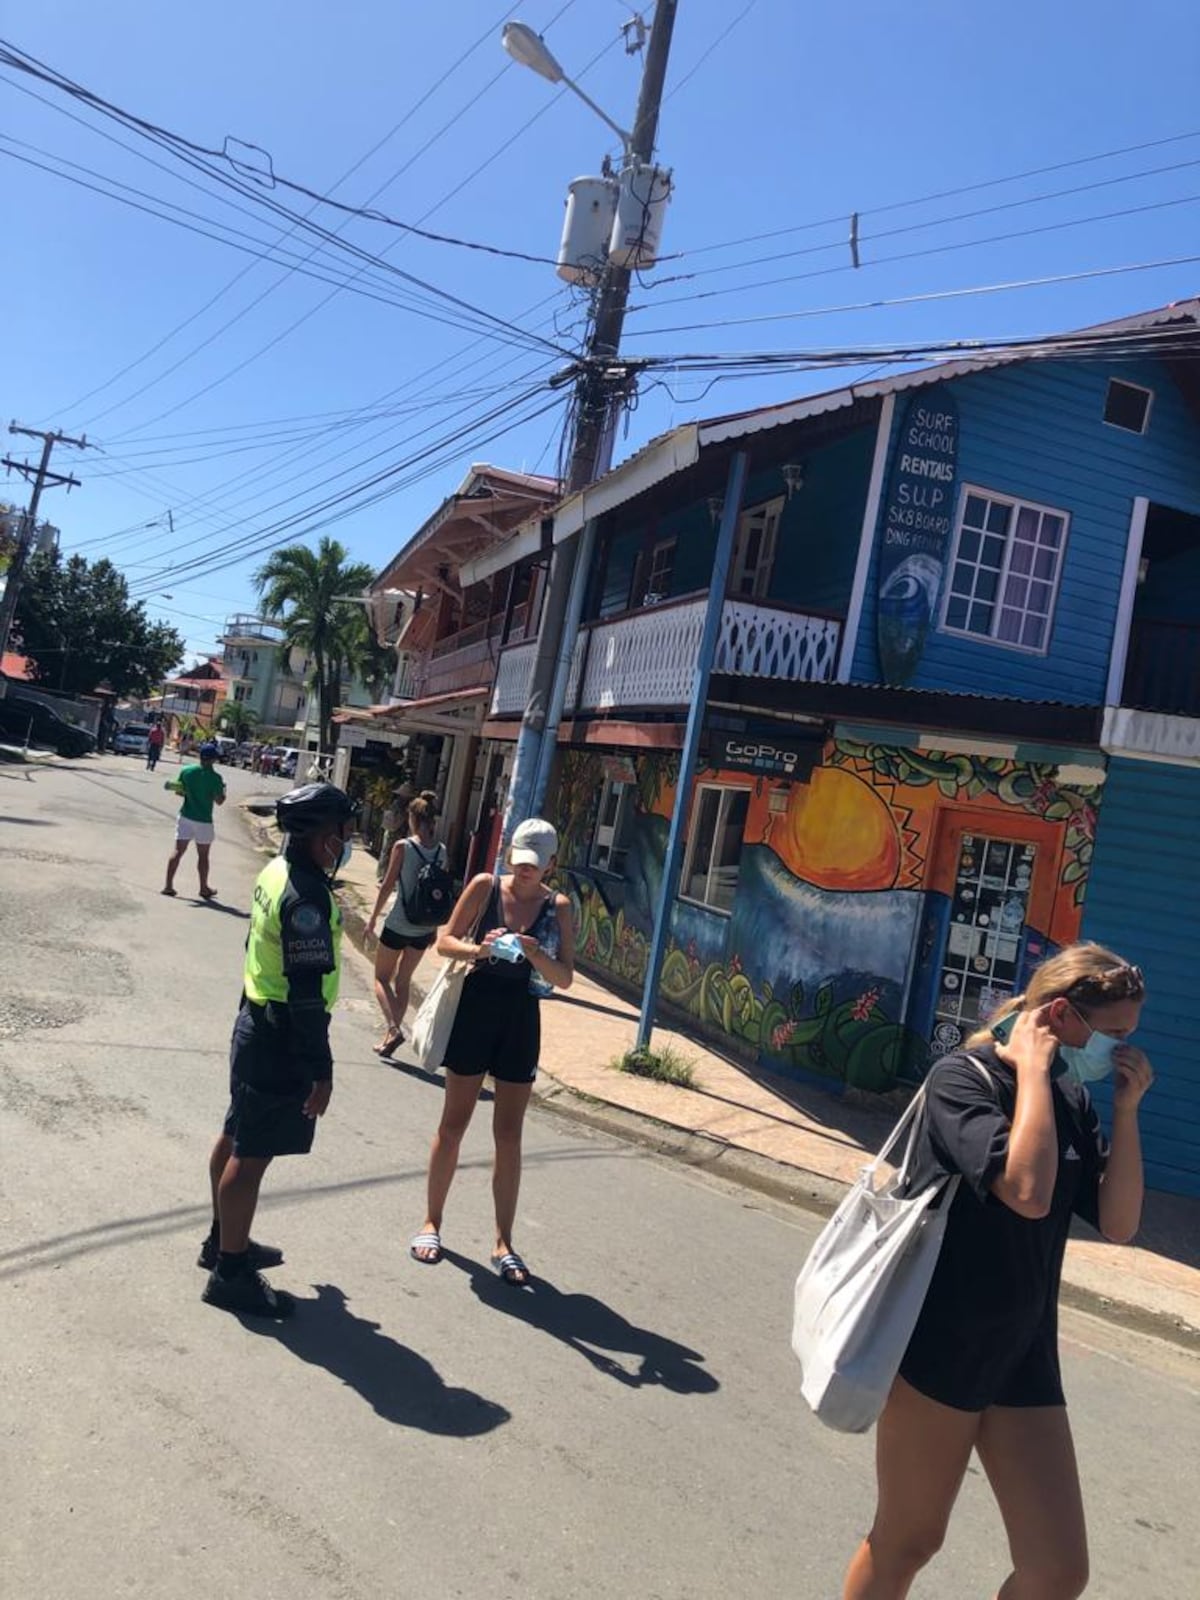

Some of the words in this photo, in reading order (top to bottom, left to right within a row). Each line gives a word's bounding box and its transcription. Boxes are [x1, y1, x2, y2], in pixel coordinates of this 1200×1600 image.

[915, 408, 953, 431] SURF
[908, 427, 955, 454] SCHOOL
[900, 454, 953, 481] RENTALS
[885, 527, 910, 546] DING
[726, 741, 798, 763] GoPro
